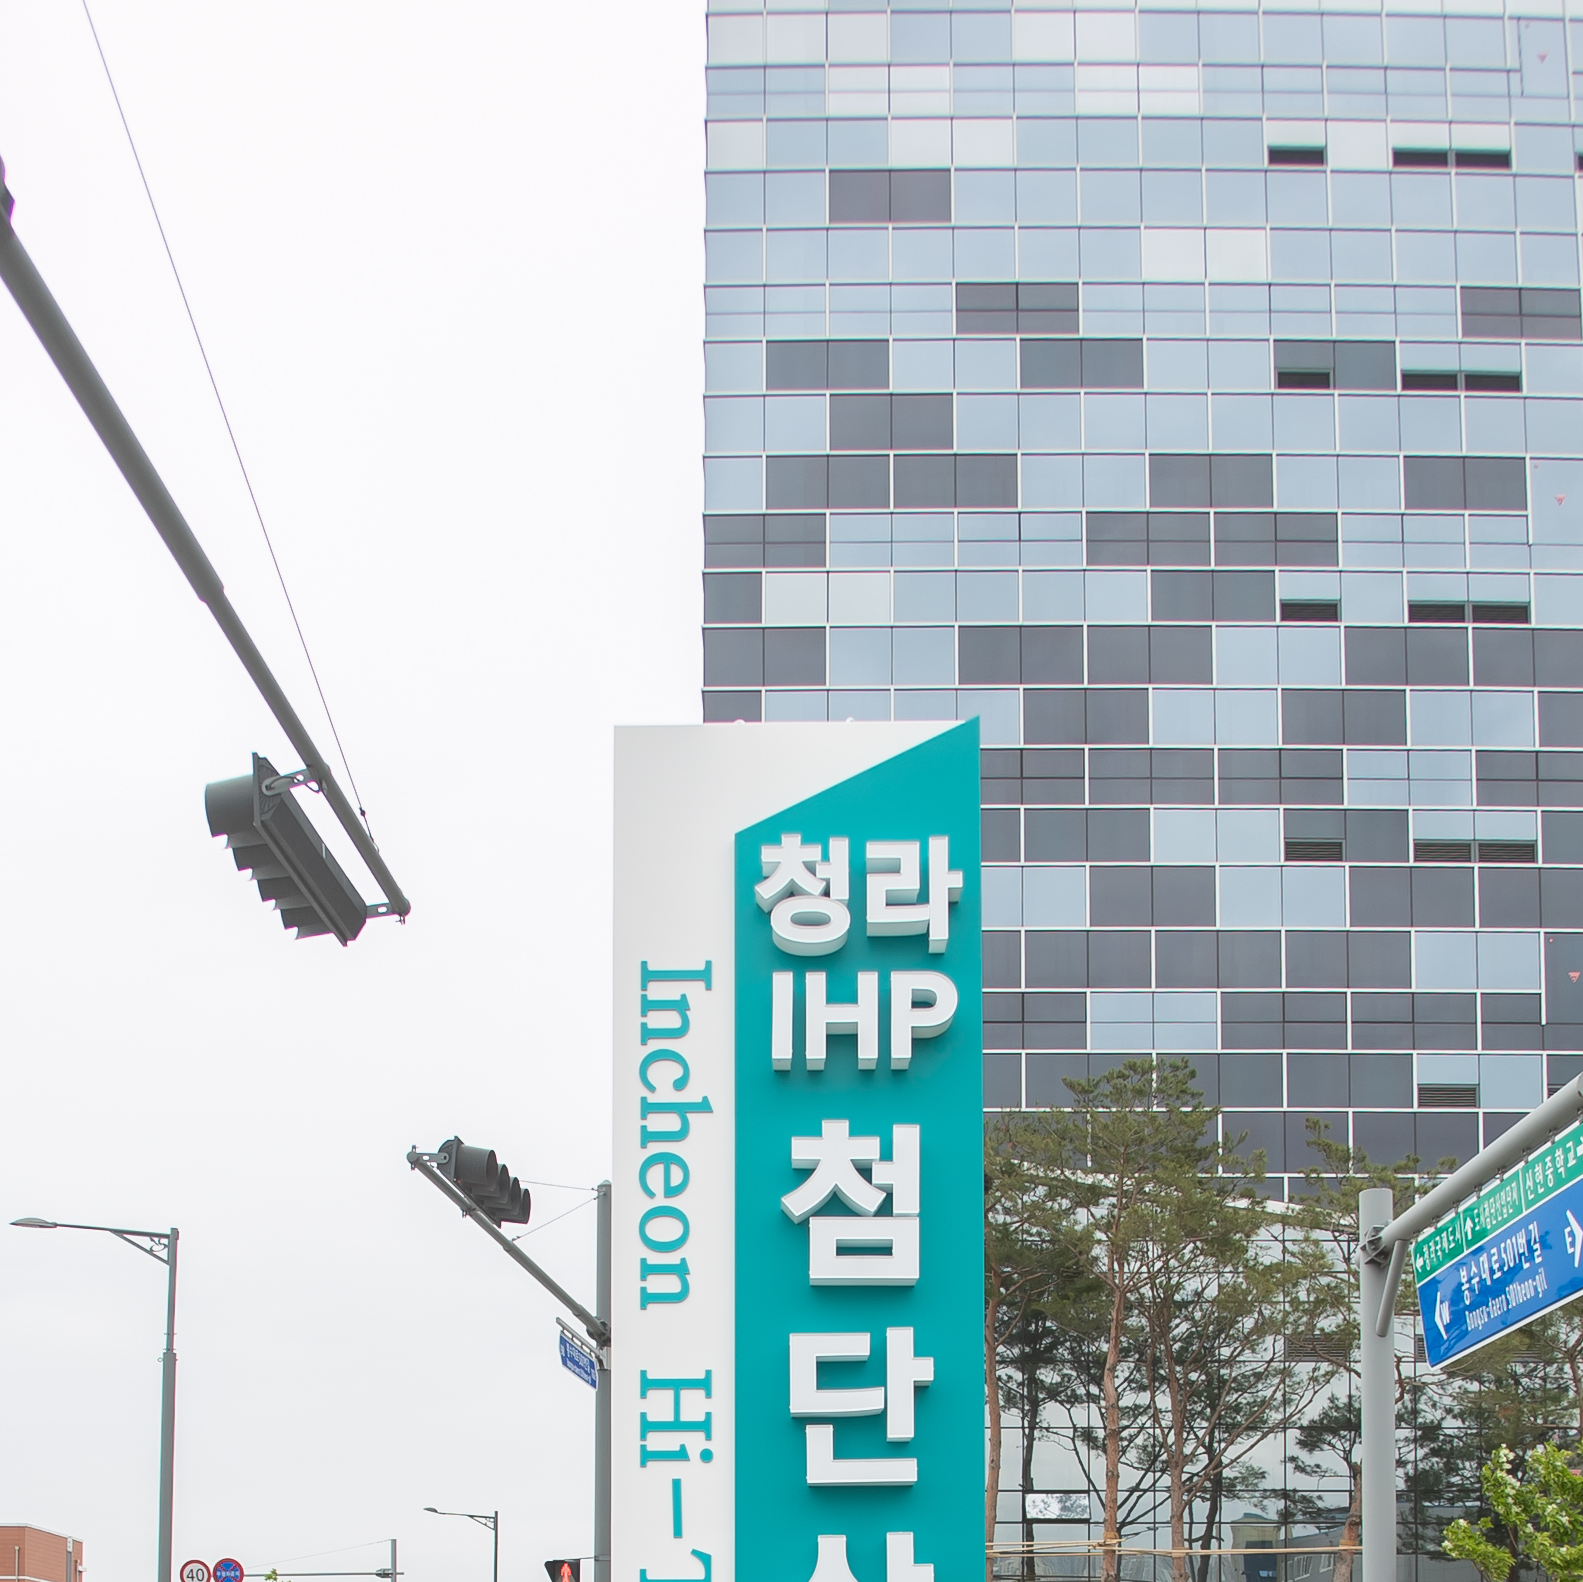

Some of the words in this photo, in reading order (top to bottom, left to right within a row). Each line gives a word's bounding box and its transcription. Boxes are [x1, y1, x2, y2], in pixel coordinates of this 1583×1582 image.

[754, 834, 964, 957] 청라
[771, 970, 959, 1071] IHP
[638, 959, 714, 1310] Incheon
[1459, 1220, 1543, 1306] 봉수대로501번길
[1564, 1226, 1575, 1255] E
[1439, 1300, 1451, 1326] W
[186, 1568, 205, 1582] 40
